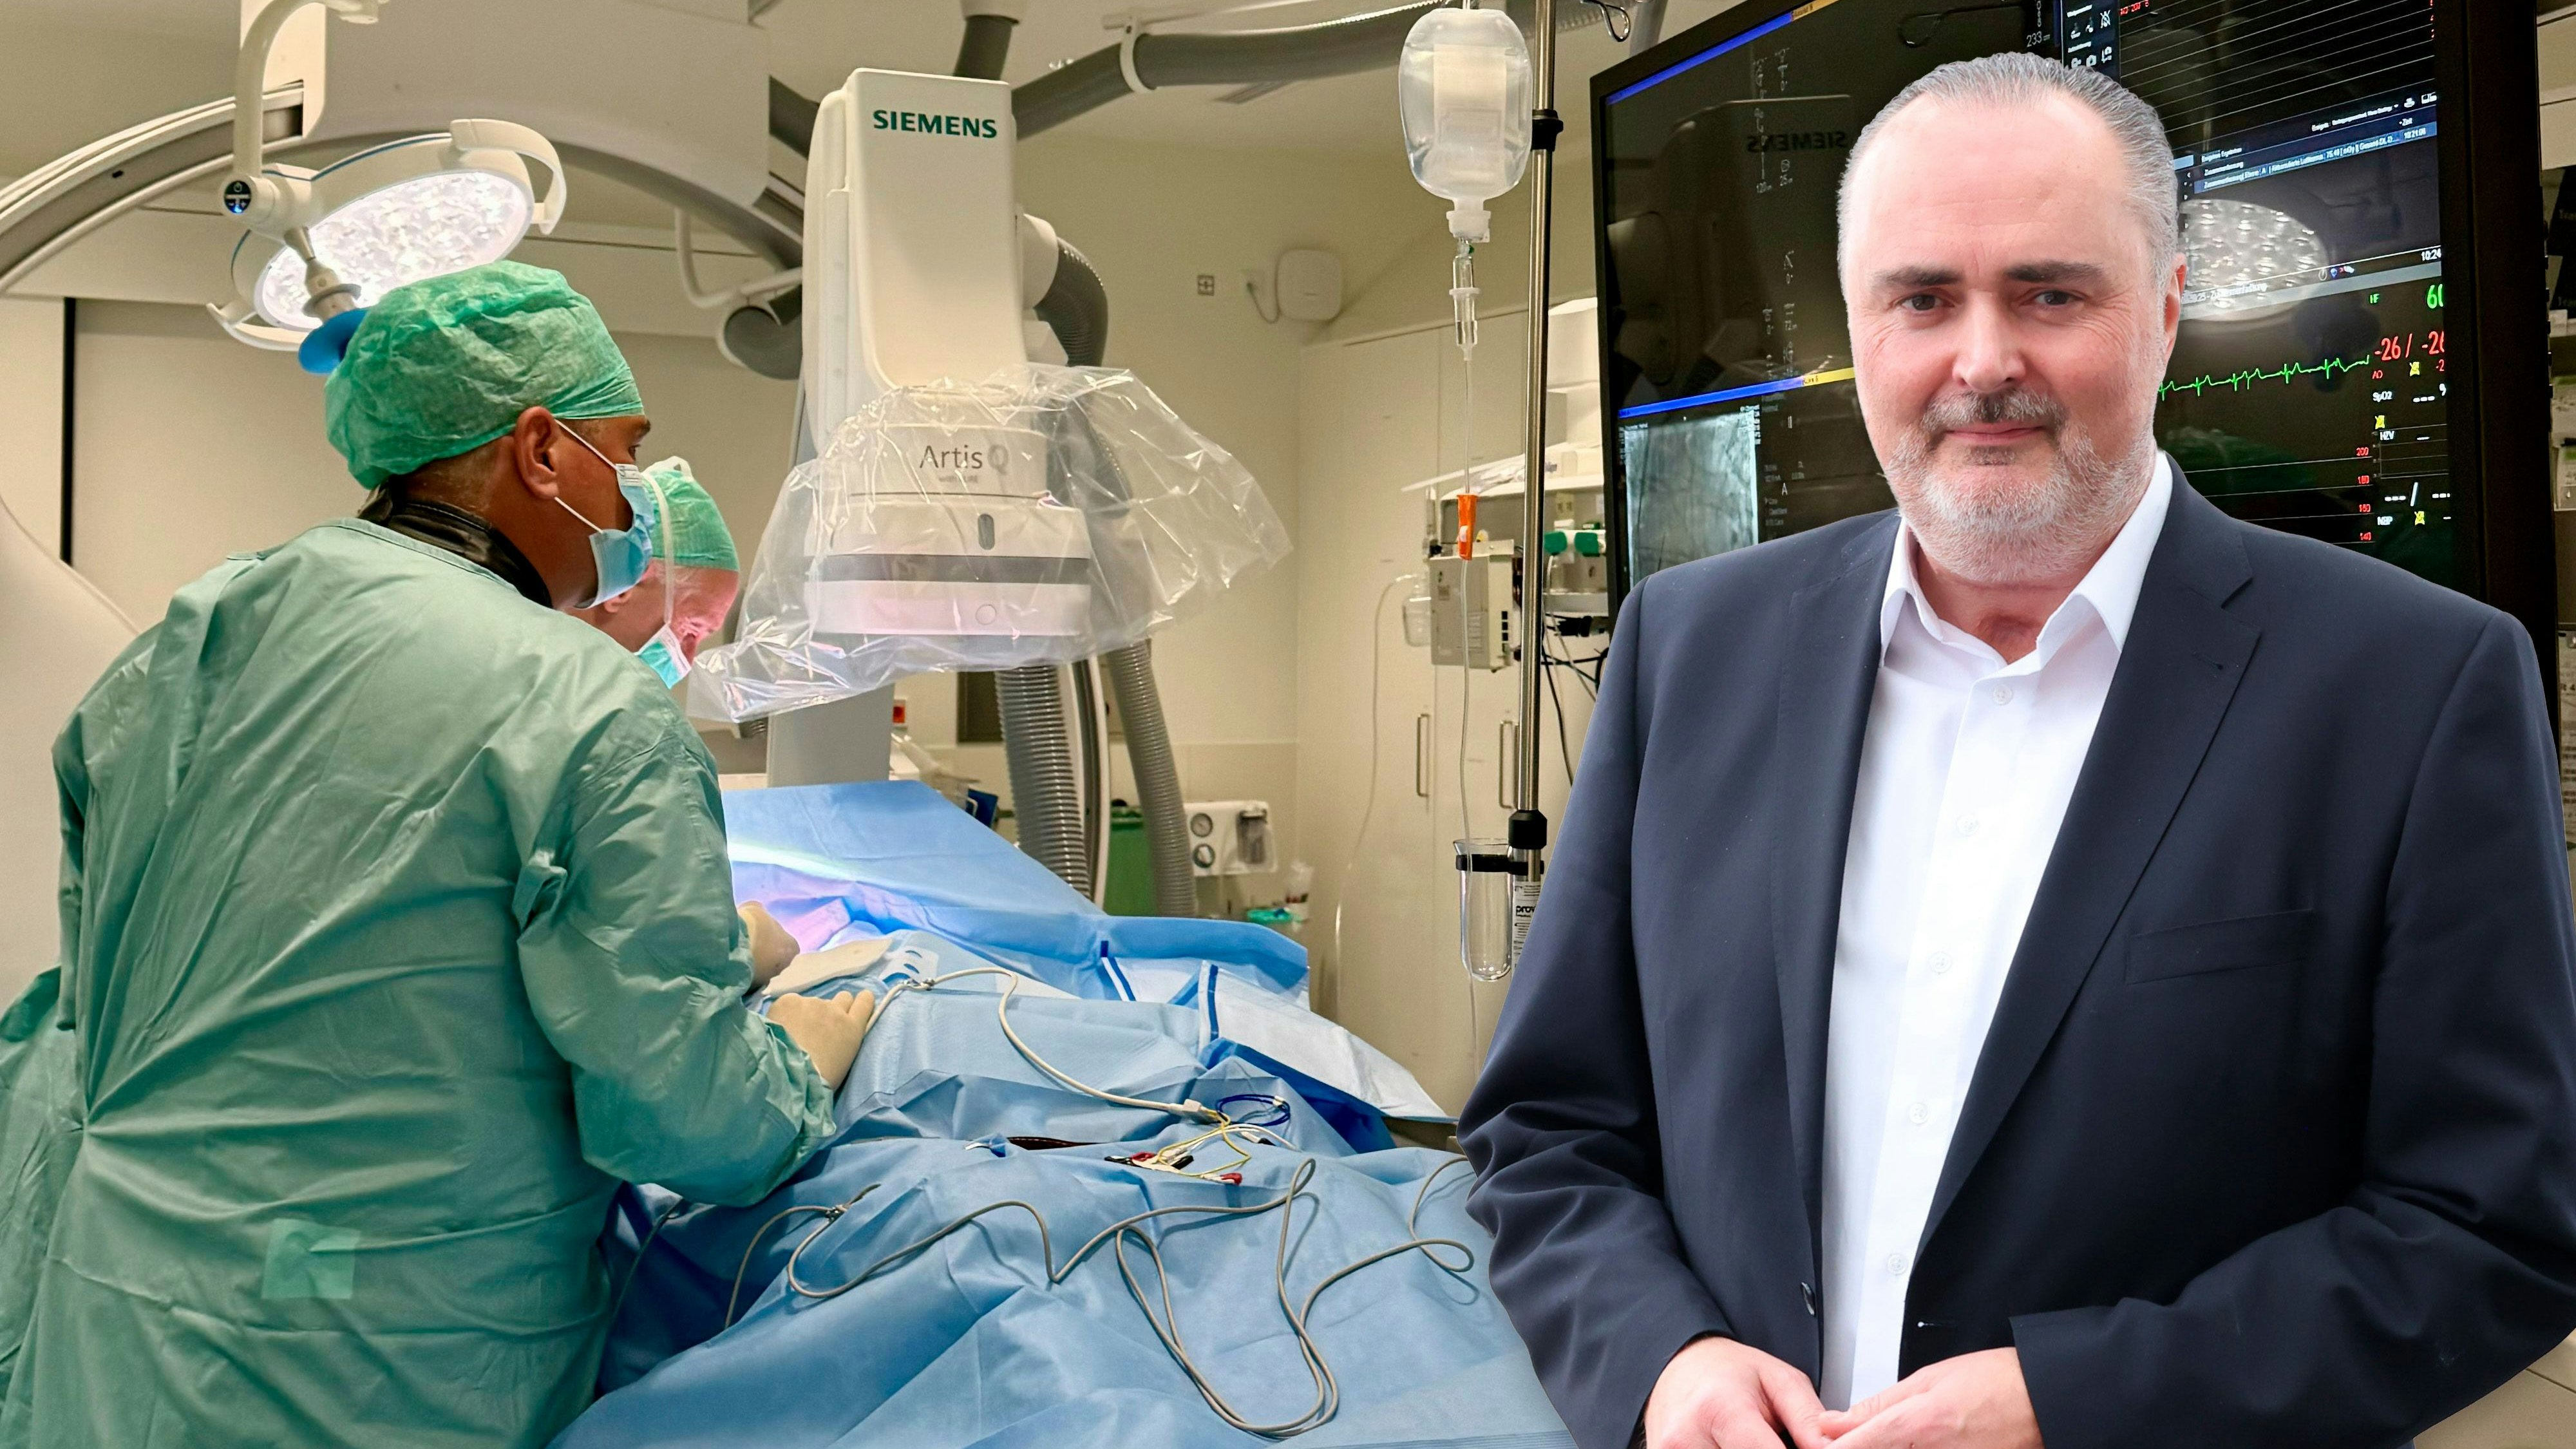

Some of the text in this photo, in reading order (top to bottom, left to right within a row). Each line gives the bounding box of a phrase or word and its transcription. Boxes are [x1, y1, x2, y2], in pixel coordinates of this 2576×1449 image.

[873, 109, 998, 138] SIEMENS
[2374, 336, 2401, 361] -26
[919, 444, 1009, 475] Artis Q
